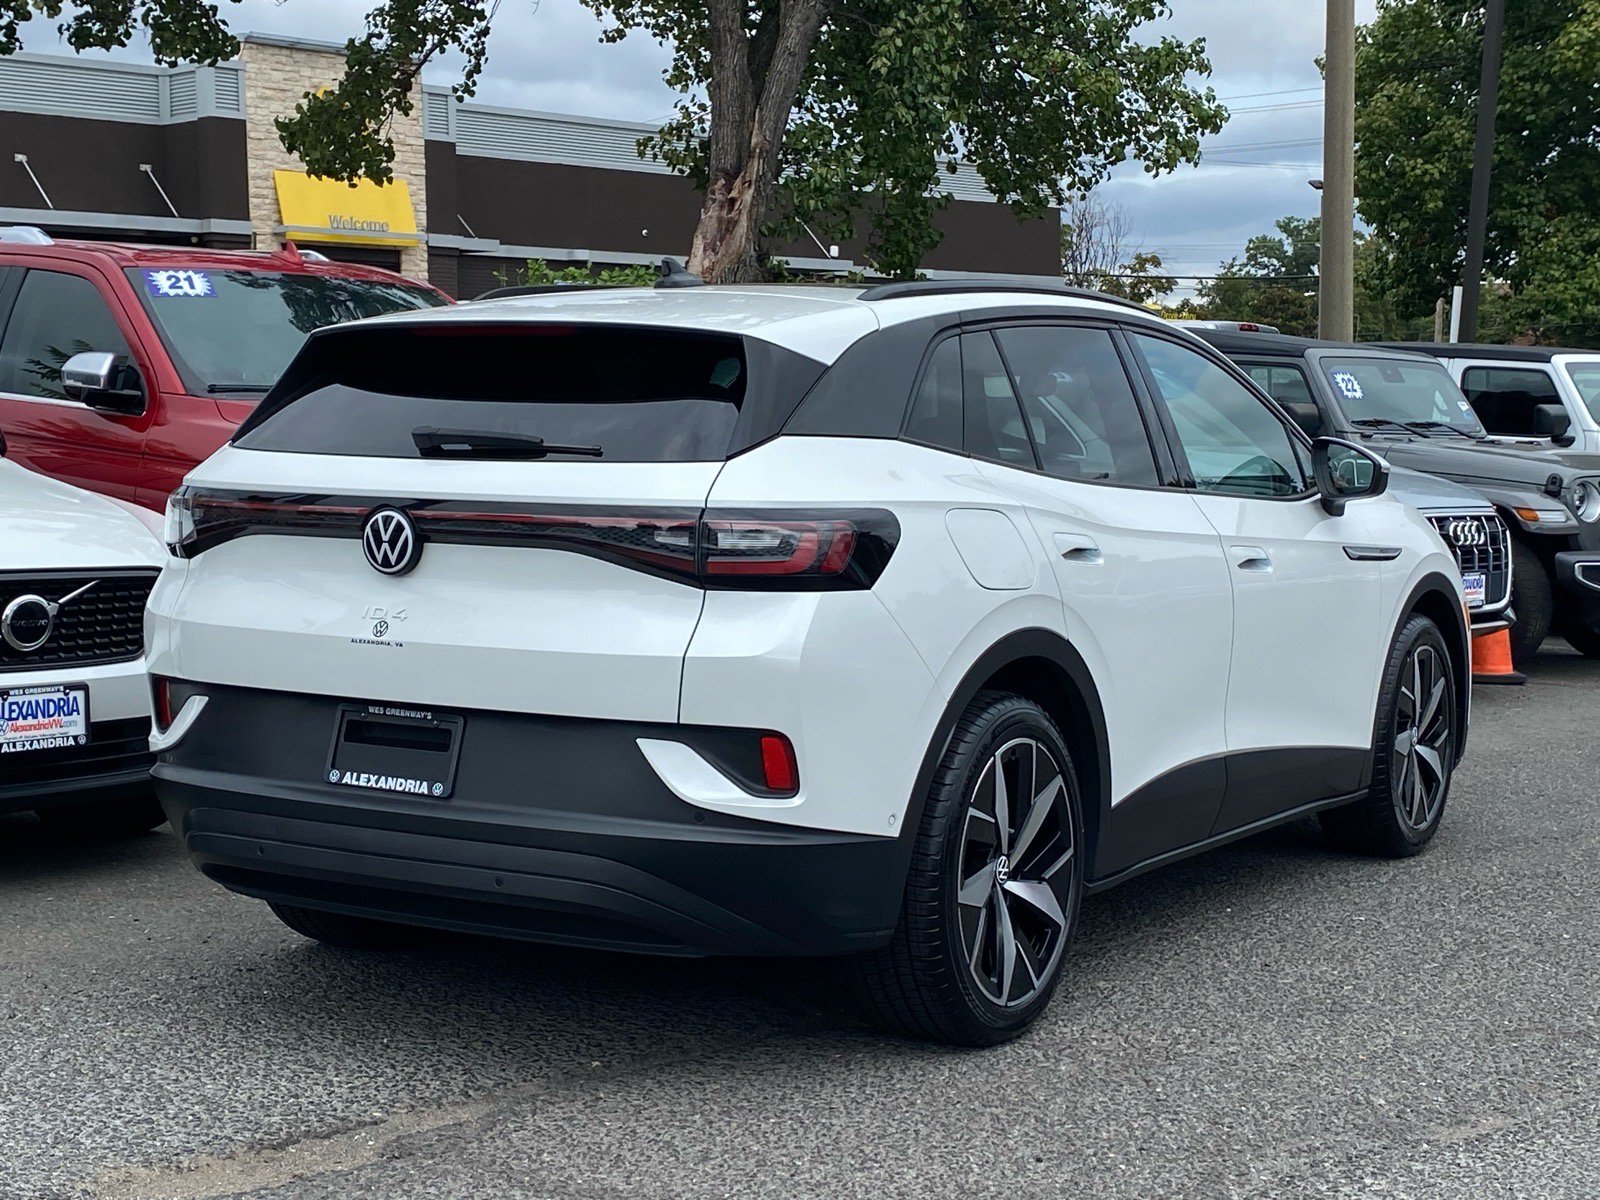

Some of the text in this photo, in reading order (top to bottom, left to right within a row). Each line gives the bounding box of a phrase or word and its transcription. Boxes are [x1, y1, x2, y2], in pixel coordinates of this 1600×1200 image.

[328, 214, 389, 232] Welcome
[166, 275, 196, 290] 21
[1341, 377, 1357, 392] 22
[0, 696, 80, 721] LEXANDRIA
[368, 705, 432, 720] WES GREENWAY'S
[1, 736, 75, 753] ALEXANDRIA
[341, 771, 429, 795] ALEXANDRIA
